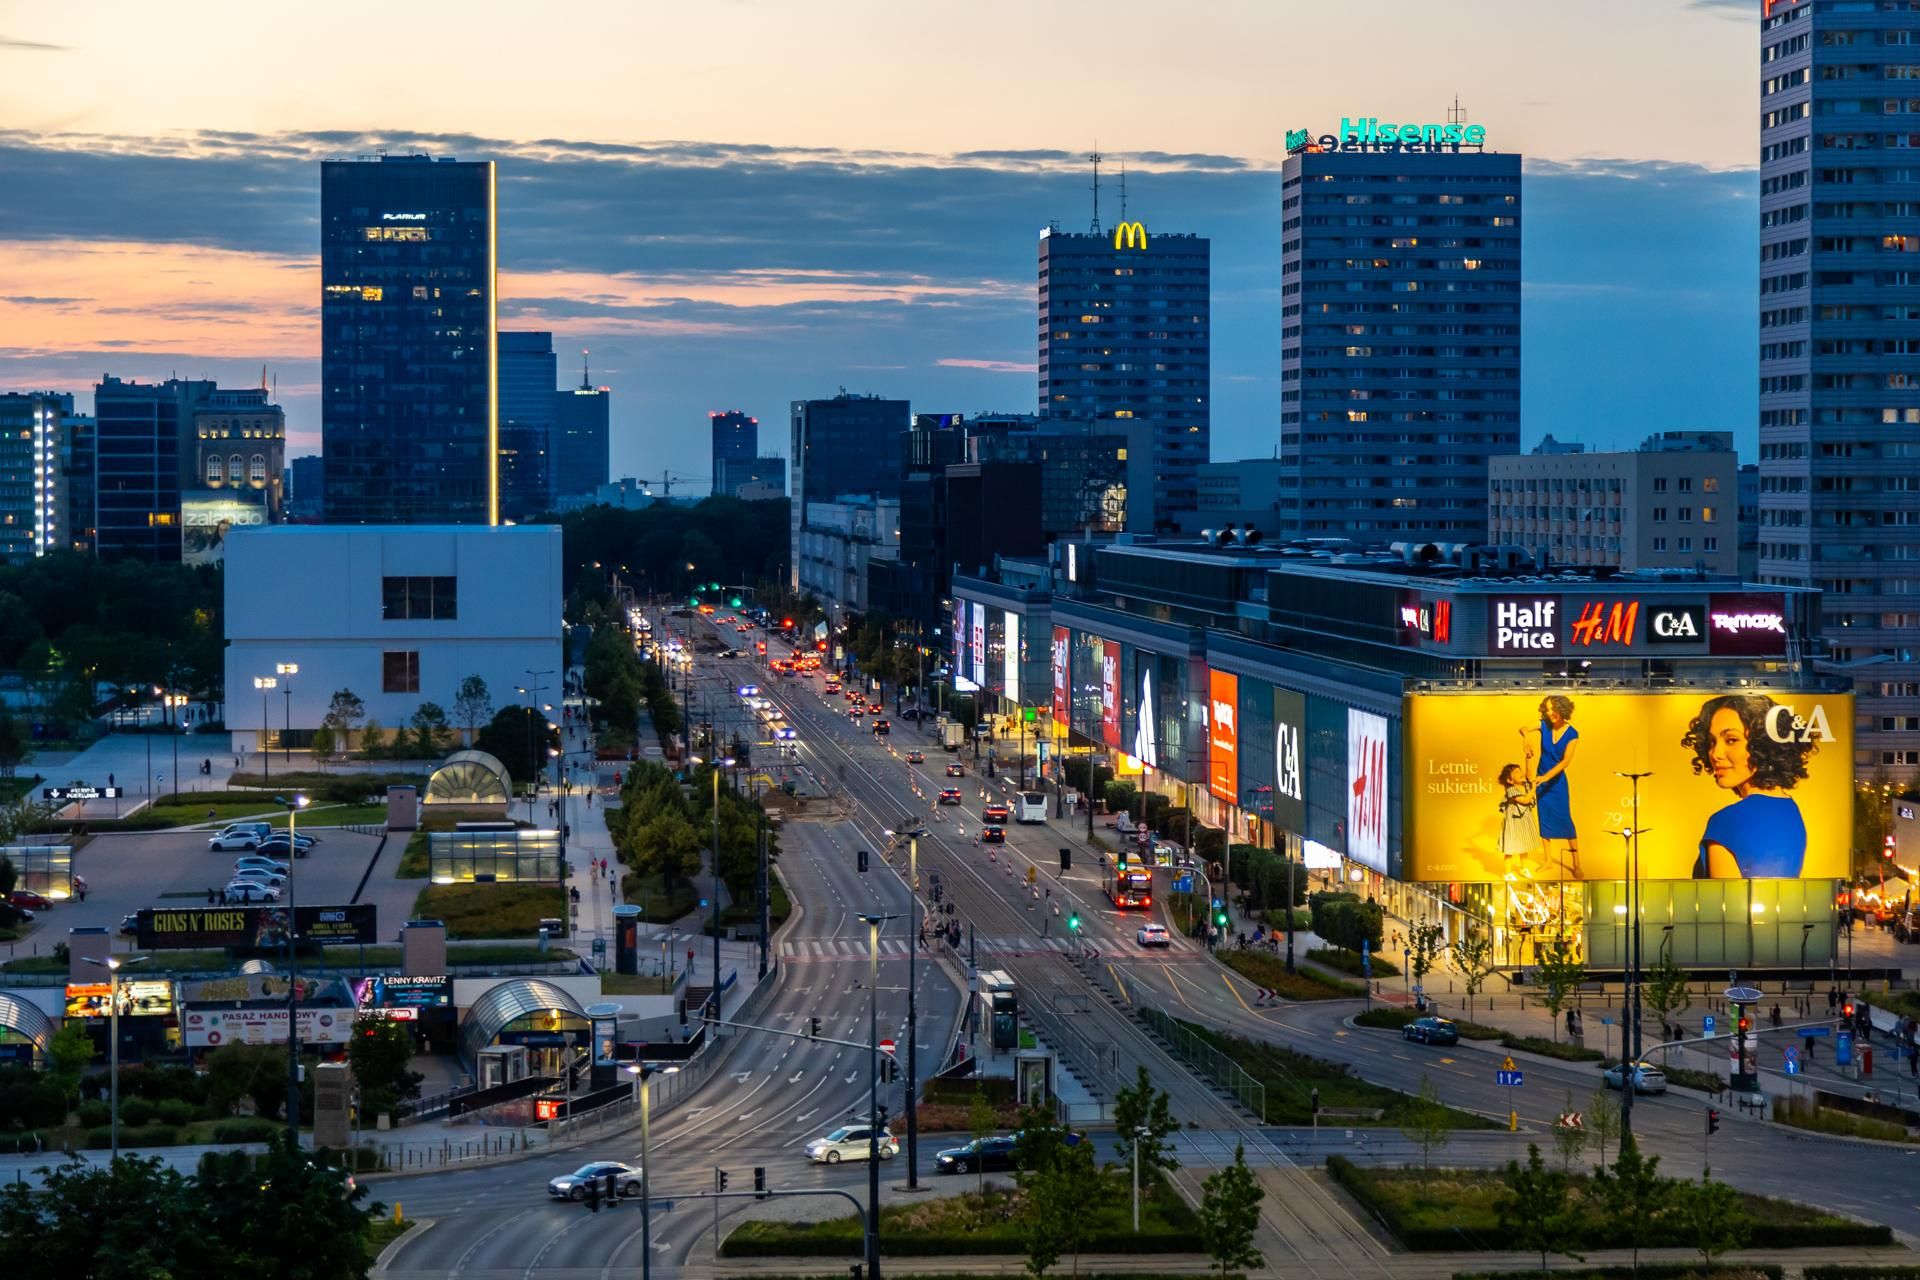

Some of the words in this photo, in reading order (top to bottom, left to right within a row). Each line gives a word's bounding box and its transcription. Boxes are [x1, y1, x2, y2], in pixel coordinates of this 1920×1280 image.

[1340, 117, 1485, 144] Hisense
[1497, 601, 1556, 628] Half
[1571, 601, 1639, 647] H&M
[1654, 612, 1699, 637] C&A
[1497, 627, 1555, 649] Price
[1765, 704, 1836, 744] C&A
[1276, 722, 1302, 801] C&A
[1427, 759, 1478, 775] Letnie
[1352, 735, 1385, 848] H&M
[1427, 777, 1493, 794] sukienki
[154, 913, 187, 932] GUNS
[204, 912, 245, 931] ROSES
[383, 977, 411, 985] LENNY
[412, 975, 447, 984] KRAVITZ
[259, 1010, 318, 1020] HANDOWY
[1706, 1017, 1713, 1027] P
